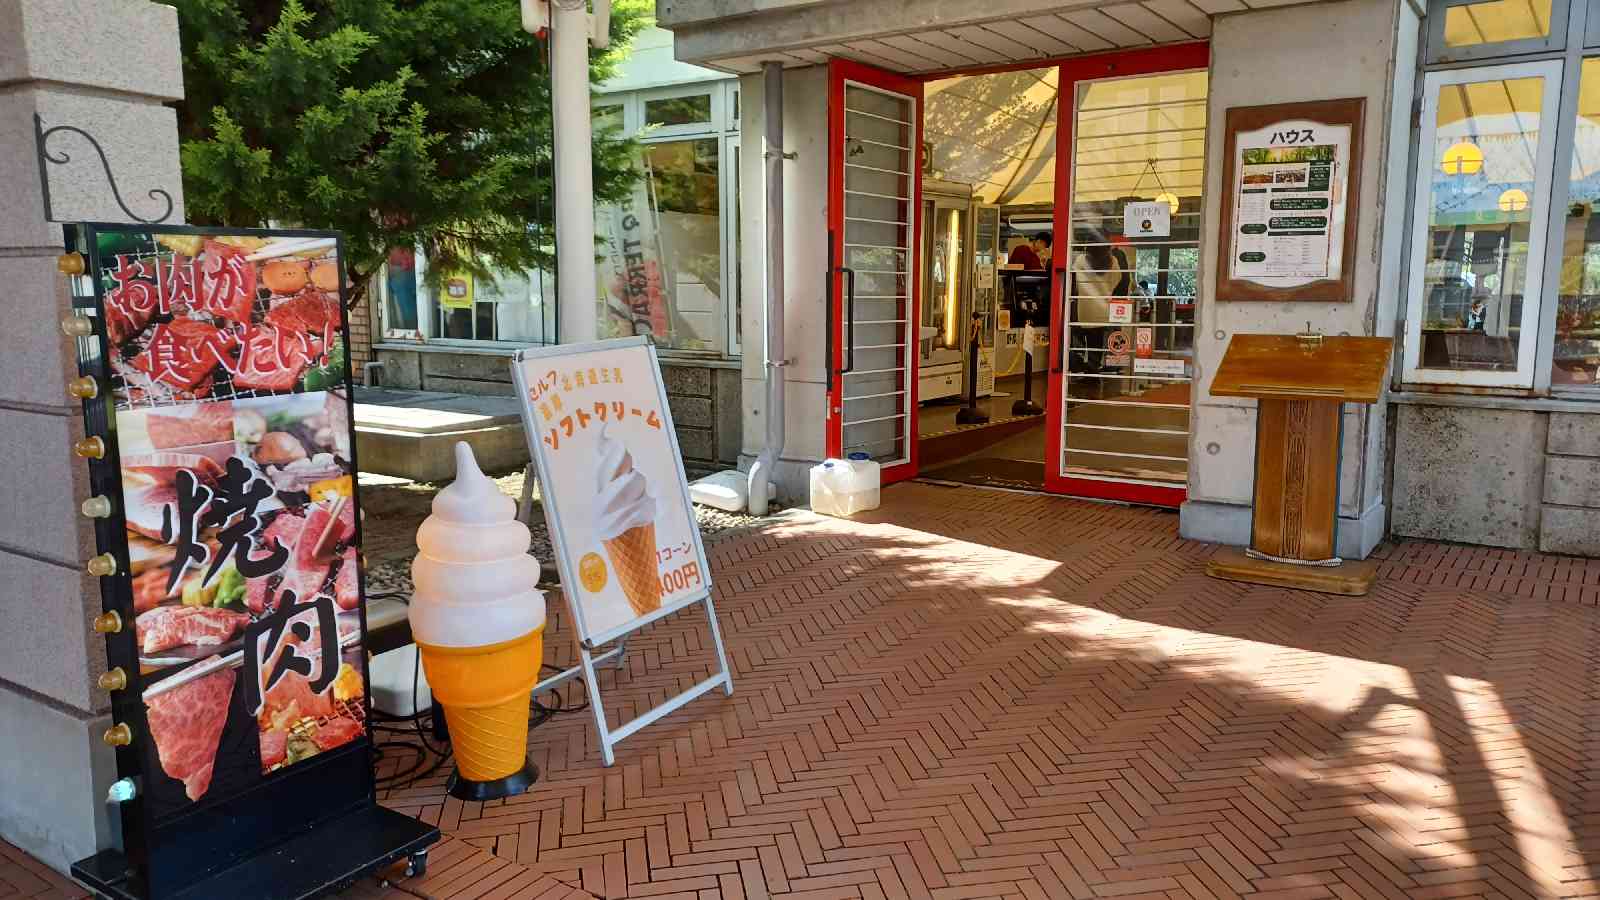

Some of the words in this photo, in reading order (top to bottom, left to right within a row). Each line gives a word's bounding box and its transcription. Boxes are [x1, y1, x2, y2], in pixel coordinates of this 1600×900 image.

[1270, 129, 1315, 144] ハウス
[1133, 207, 1160, 217] OPEN
[110, 253, 248, 330] お肉が
[529, 370, 557, 401] セルフ
[544, 401, 662, 450] ソフトクリーム
[164, 455, 342, 718] 焼肉
